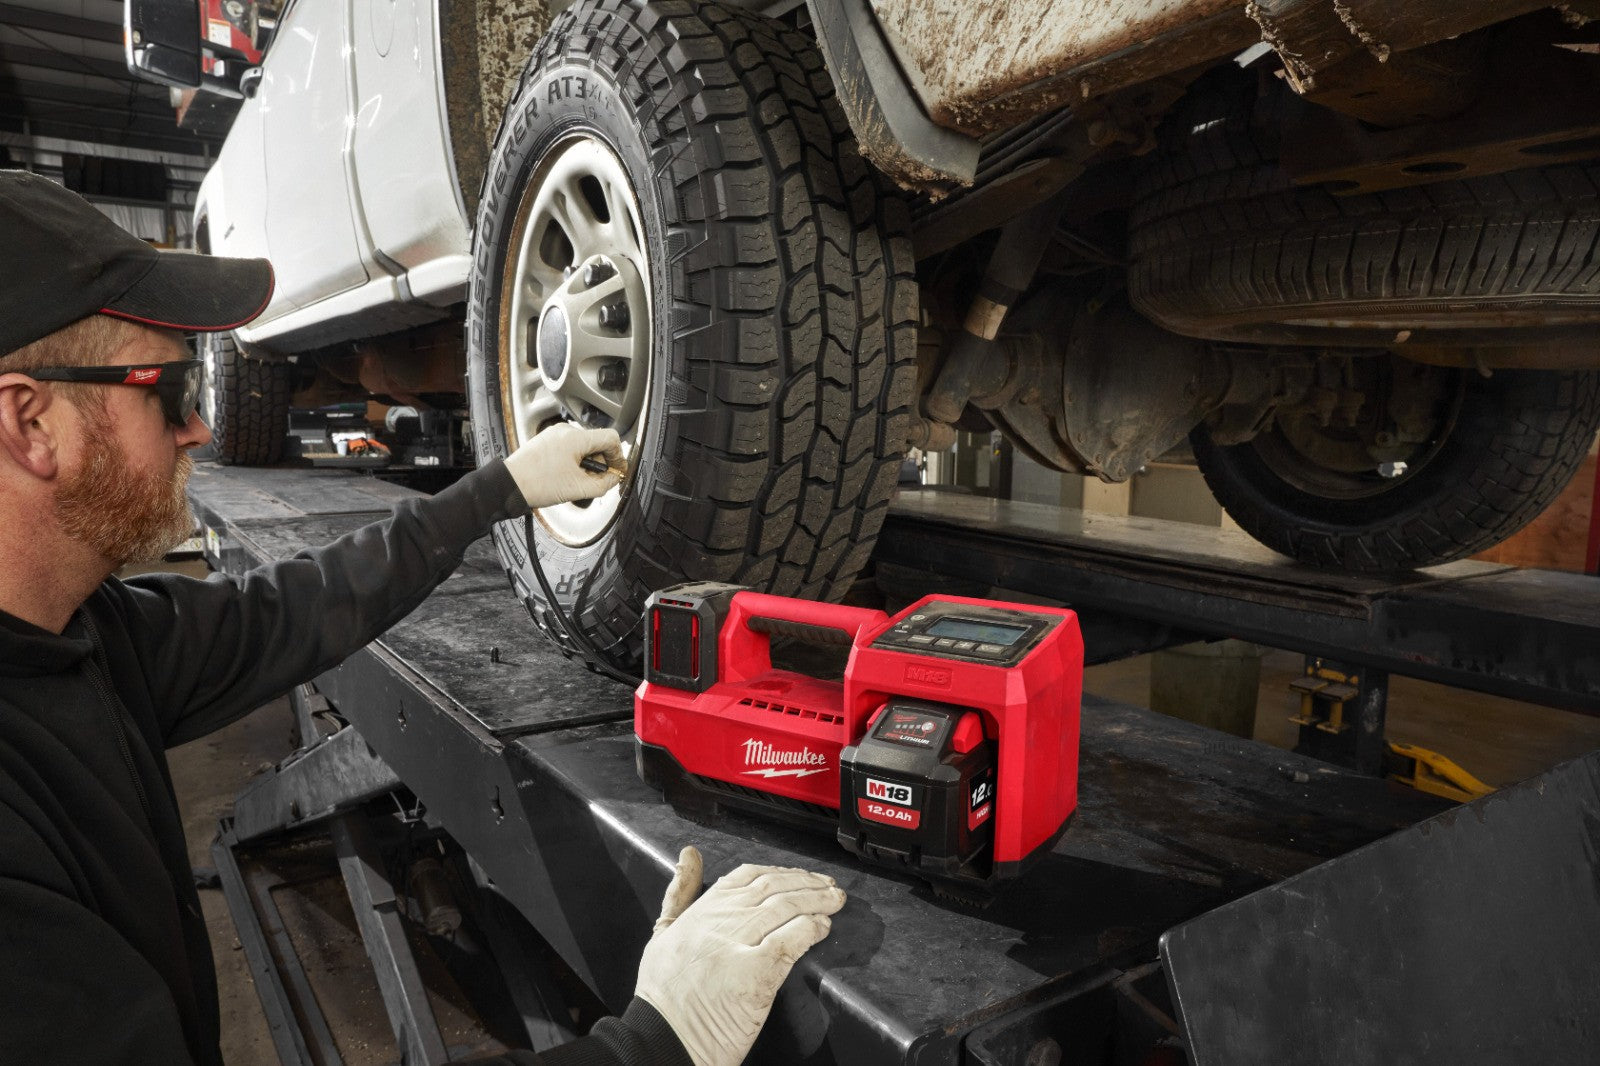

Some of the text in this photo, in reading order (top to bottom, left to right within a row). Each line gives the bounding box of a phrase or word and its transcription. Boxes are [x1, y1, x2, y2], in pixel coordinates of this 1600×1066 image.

[471, 96, 540, 352] DISCOVERER
[906, 665, 949, 684] M18
[740, 738, 826, 766] Milwaukee
[868, 781, 910, 802] M18
